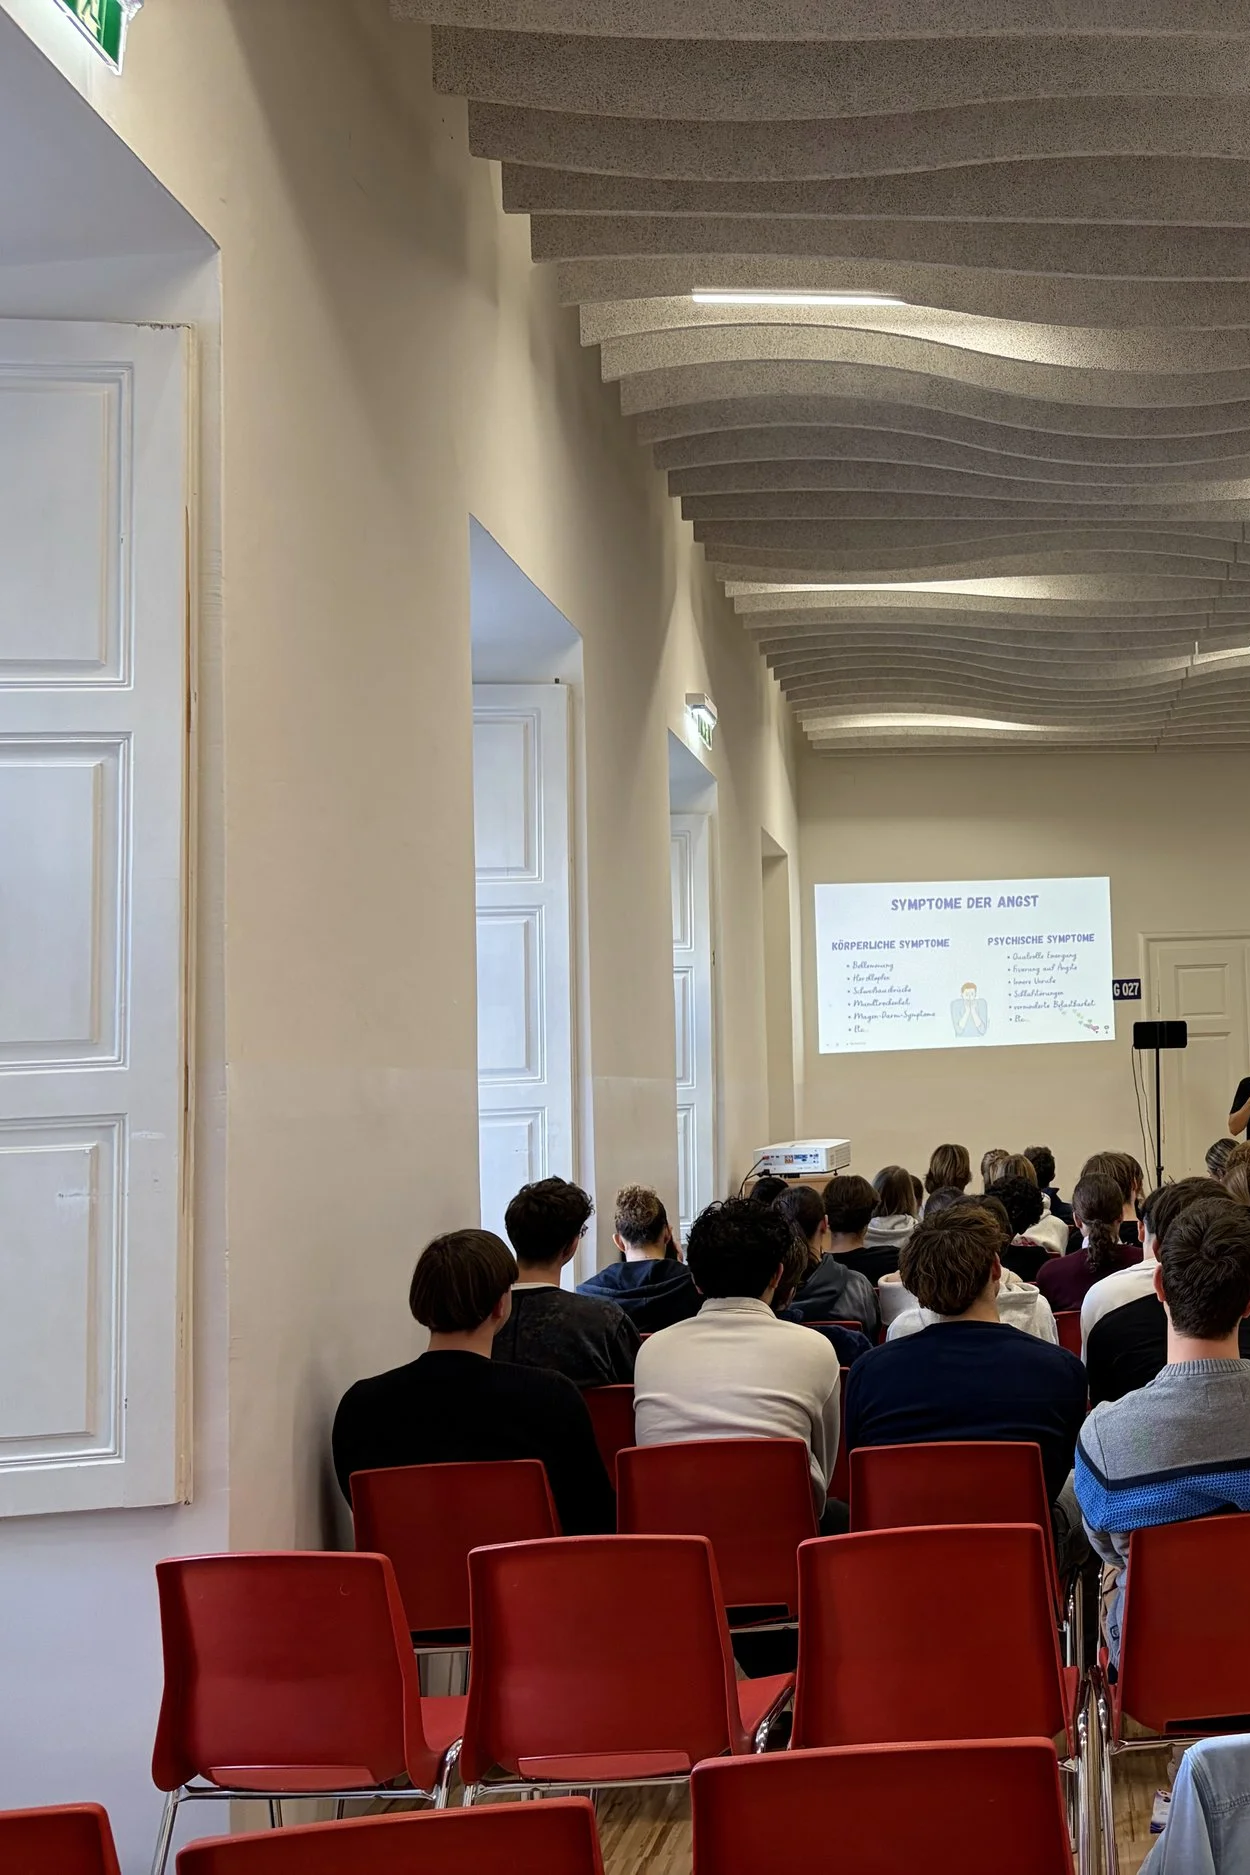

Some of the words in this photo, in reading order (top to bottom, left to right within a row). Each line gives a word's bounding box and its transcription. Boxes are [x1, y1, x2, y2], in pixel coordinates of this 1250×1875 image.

[891, 897, 962, 911] SYMPTOME
[966, 896, 992, 909] DER
[998, 895, 1040, 908] ANGST
[831, 939, 896, 951] KÖRPERLICHE
[899, 938, 950, 949] SYMPTOME
[987, 935, 1044, 946] PSYCHISCHE
[1047, 933, 1095, 944] SYMPTOME
[1122, 982, 1140, 996] 027
